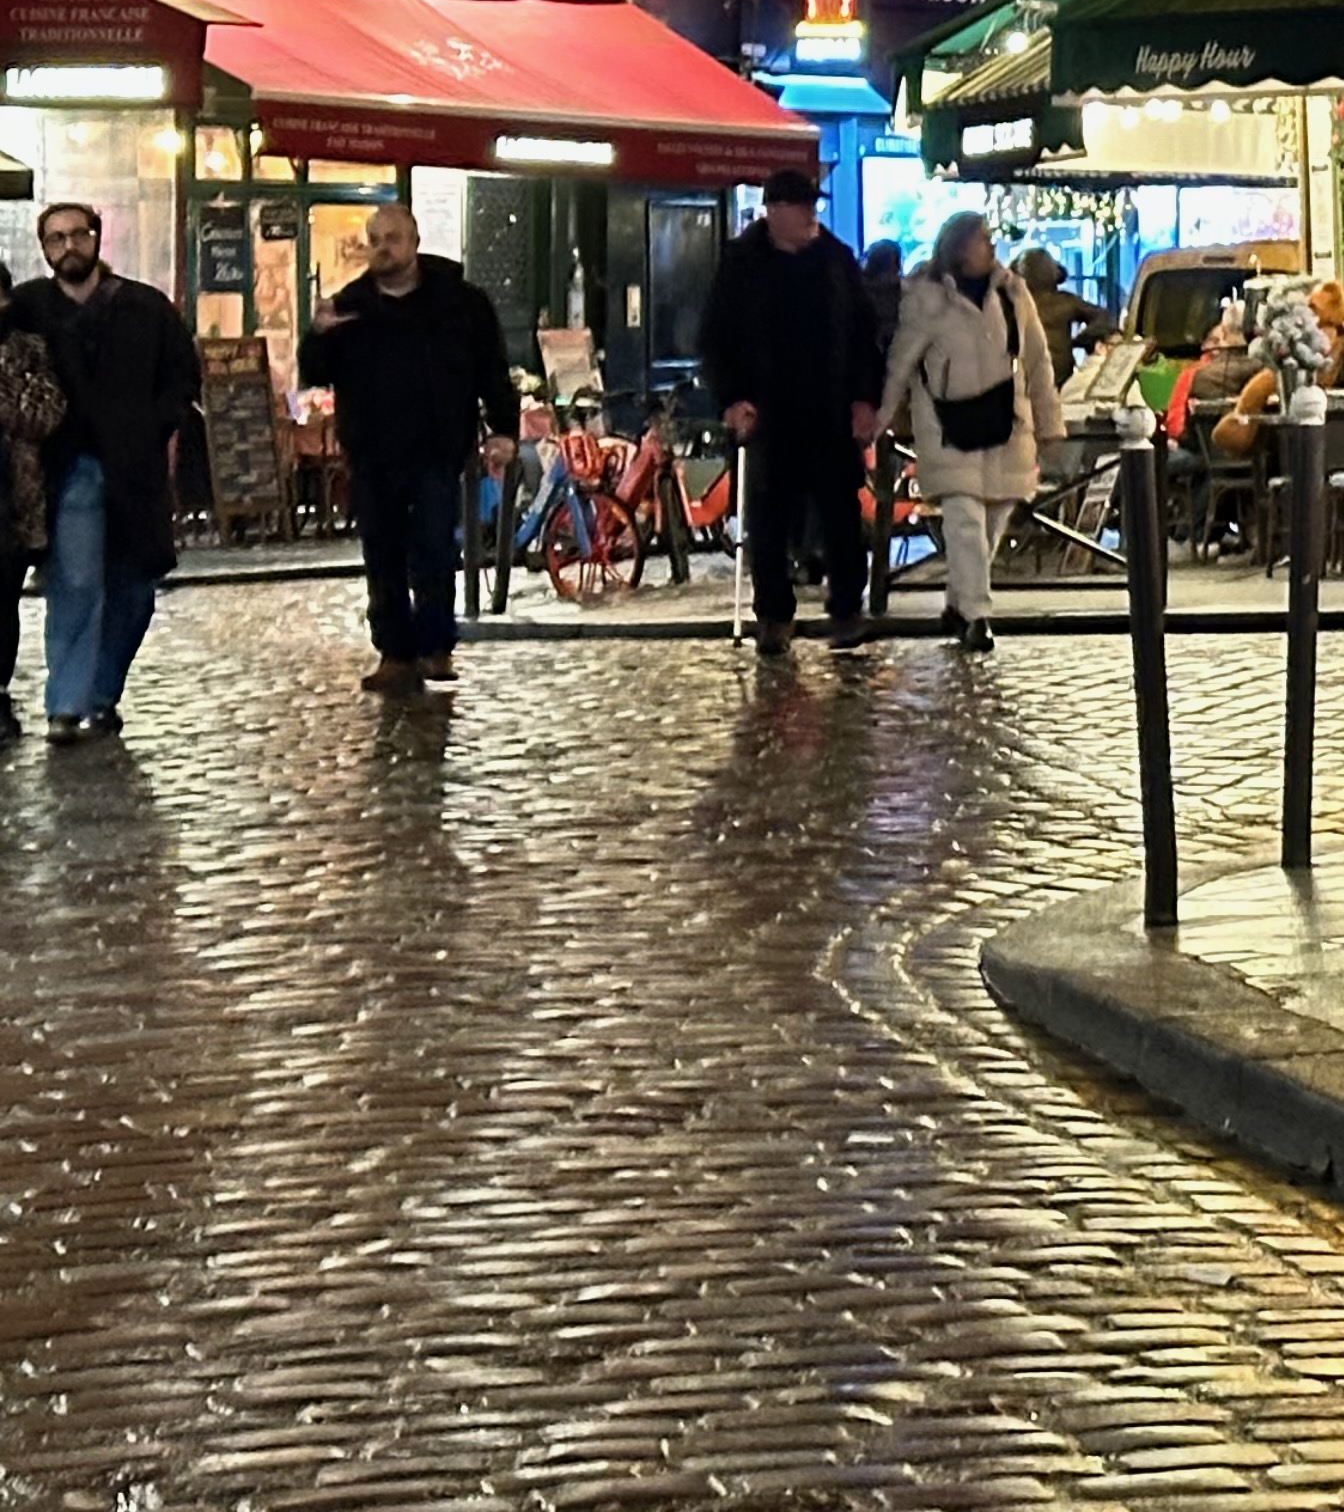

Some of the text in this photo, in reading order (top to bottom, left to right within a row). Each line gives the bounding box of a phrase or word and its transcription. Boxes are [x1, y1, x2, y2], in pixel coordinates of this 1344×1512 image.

[9, 7, 66, 21] CUISINE
[18, 27, 145, 42] TRADITIONNELLE
[1135, 40, 1256, 80] Happy Hour
